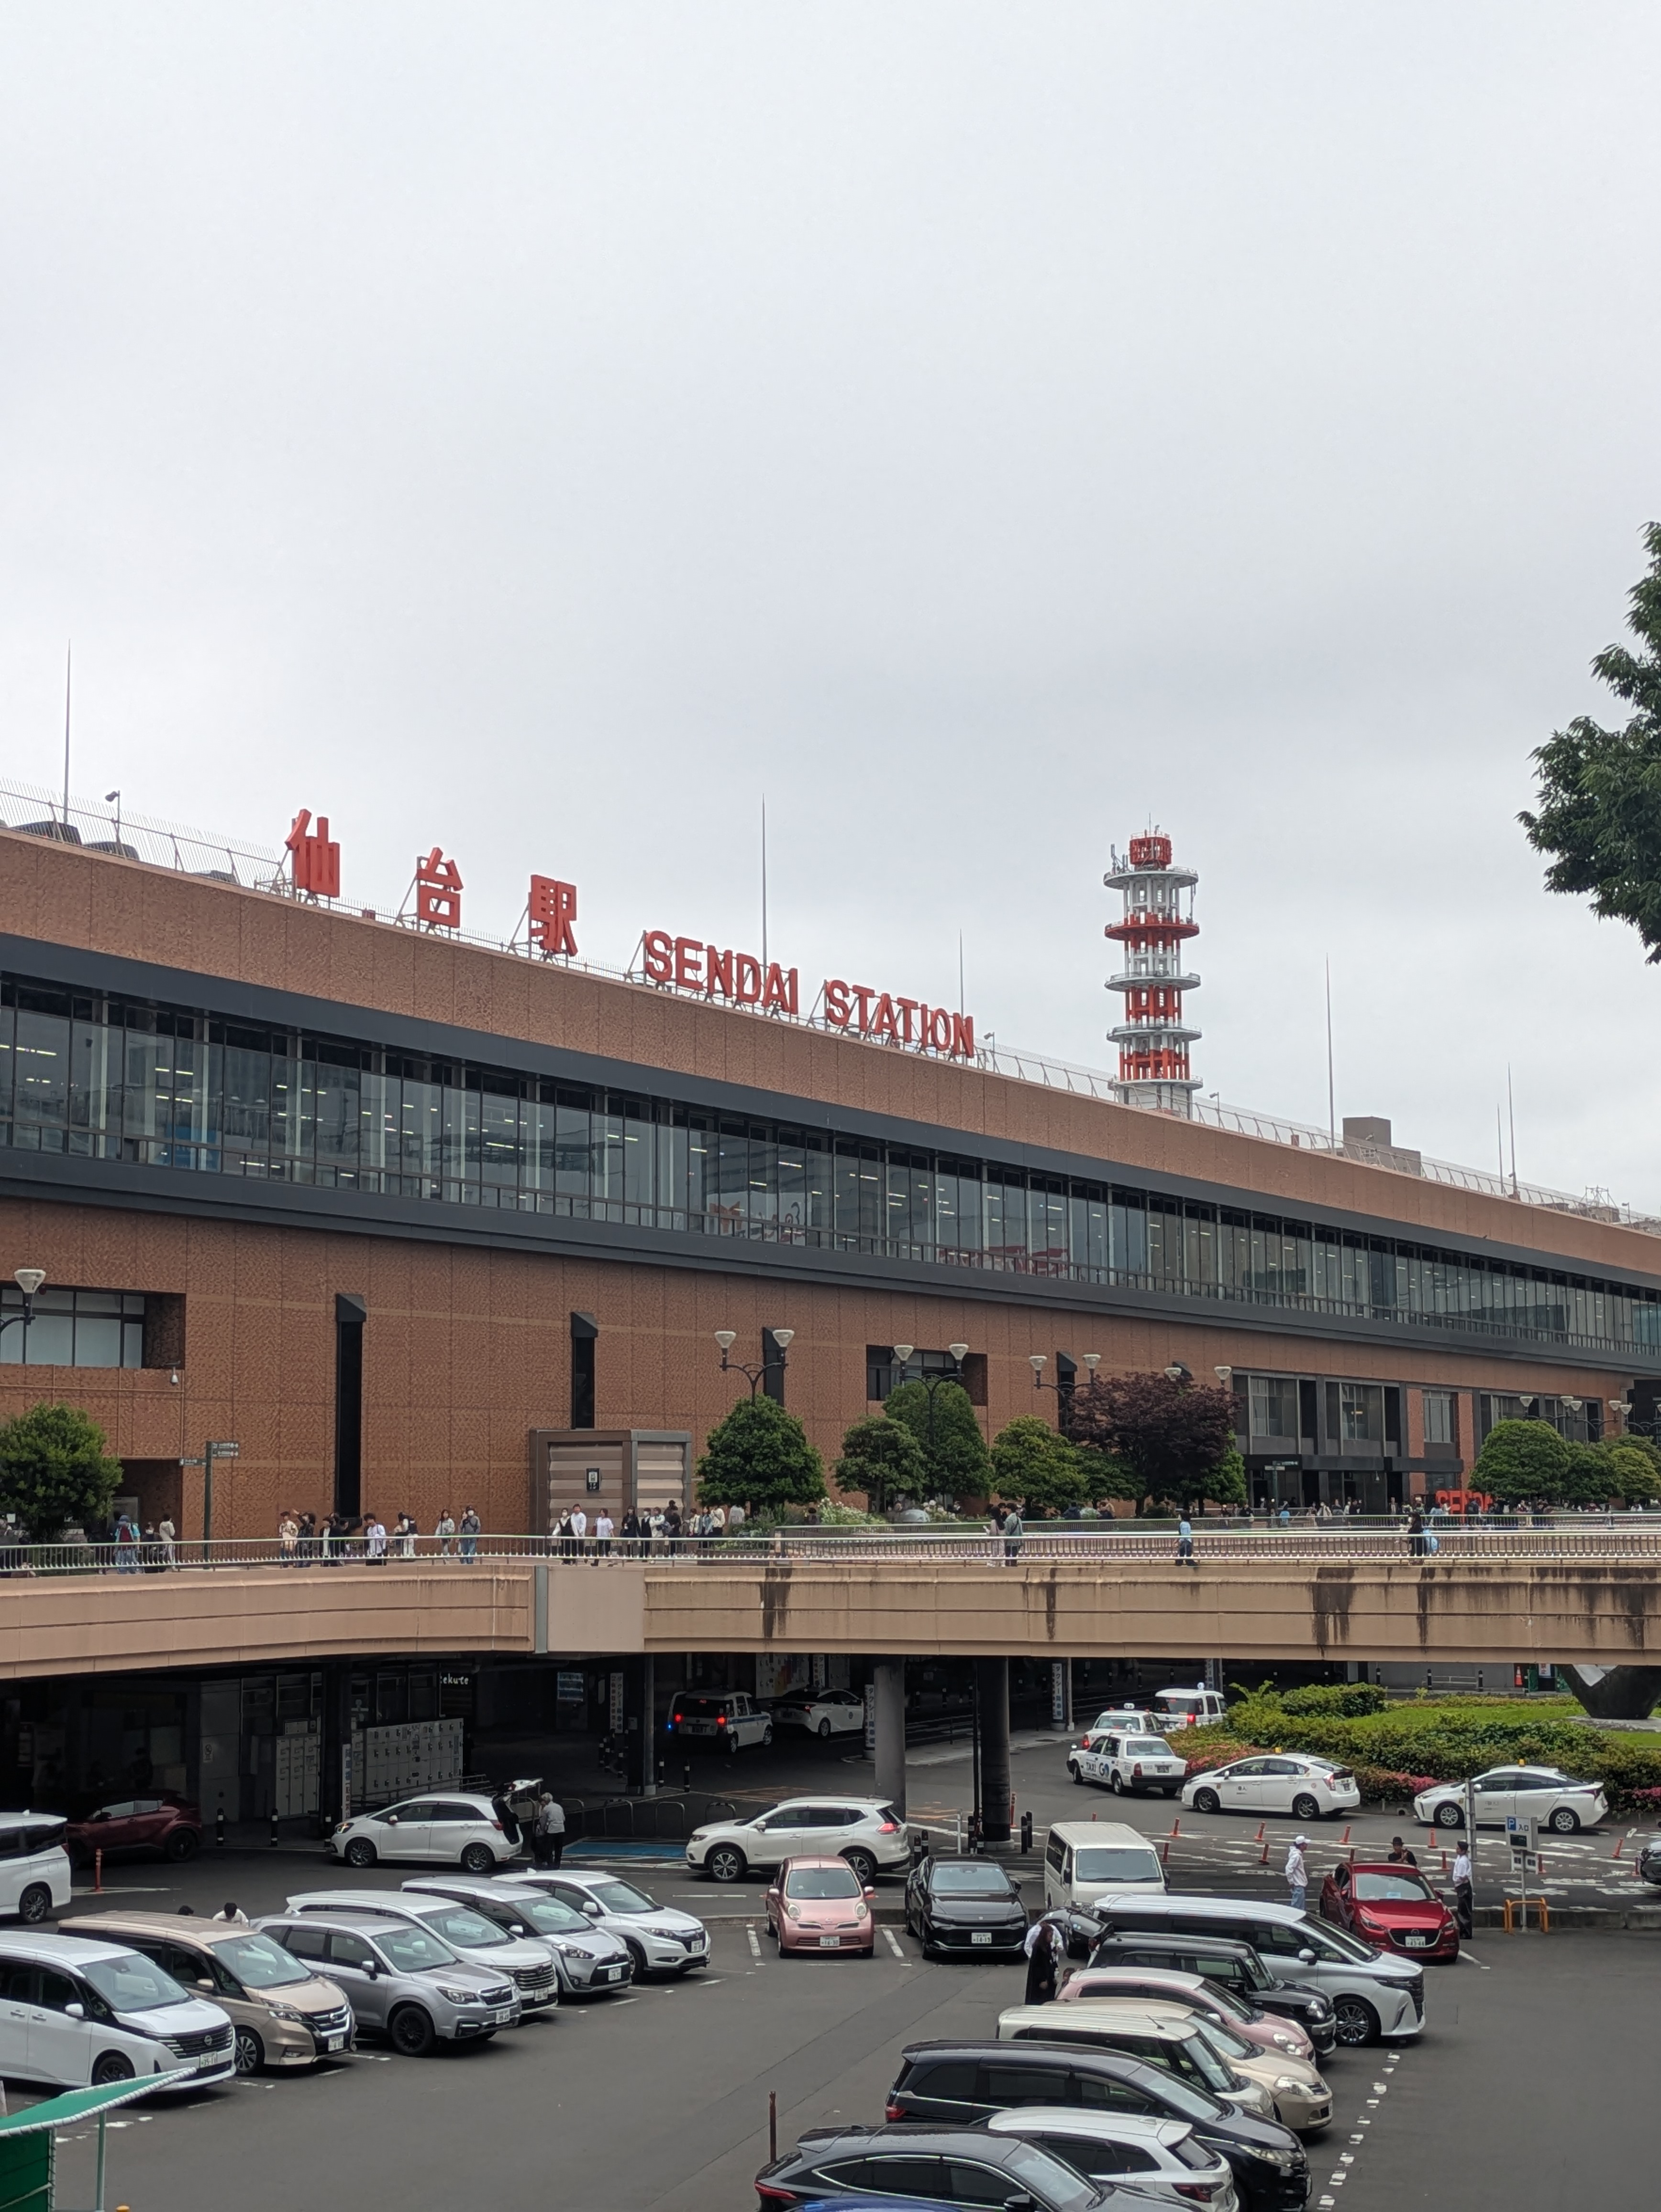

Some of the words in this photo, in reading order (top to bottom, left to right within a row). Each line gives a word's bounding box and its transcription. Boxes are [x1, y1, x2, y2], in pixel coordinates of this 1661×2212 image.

[287, 810, 577, 955] 仙台駅
[644, 931, 798, 1015] SENDAI
[825, 980, 974, 1056] STATION
